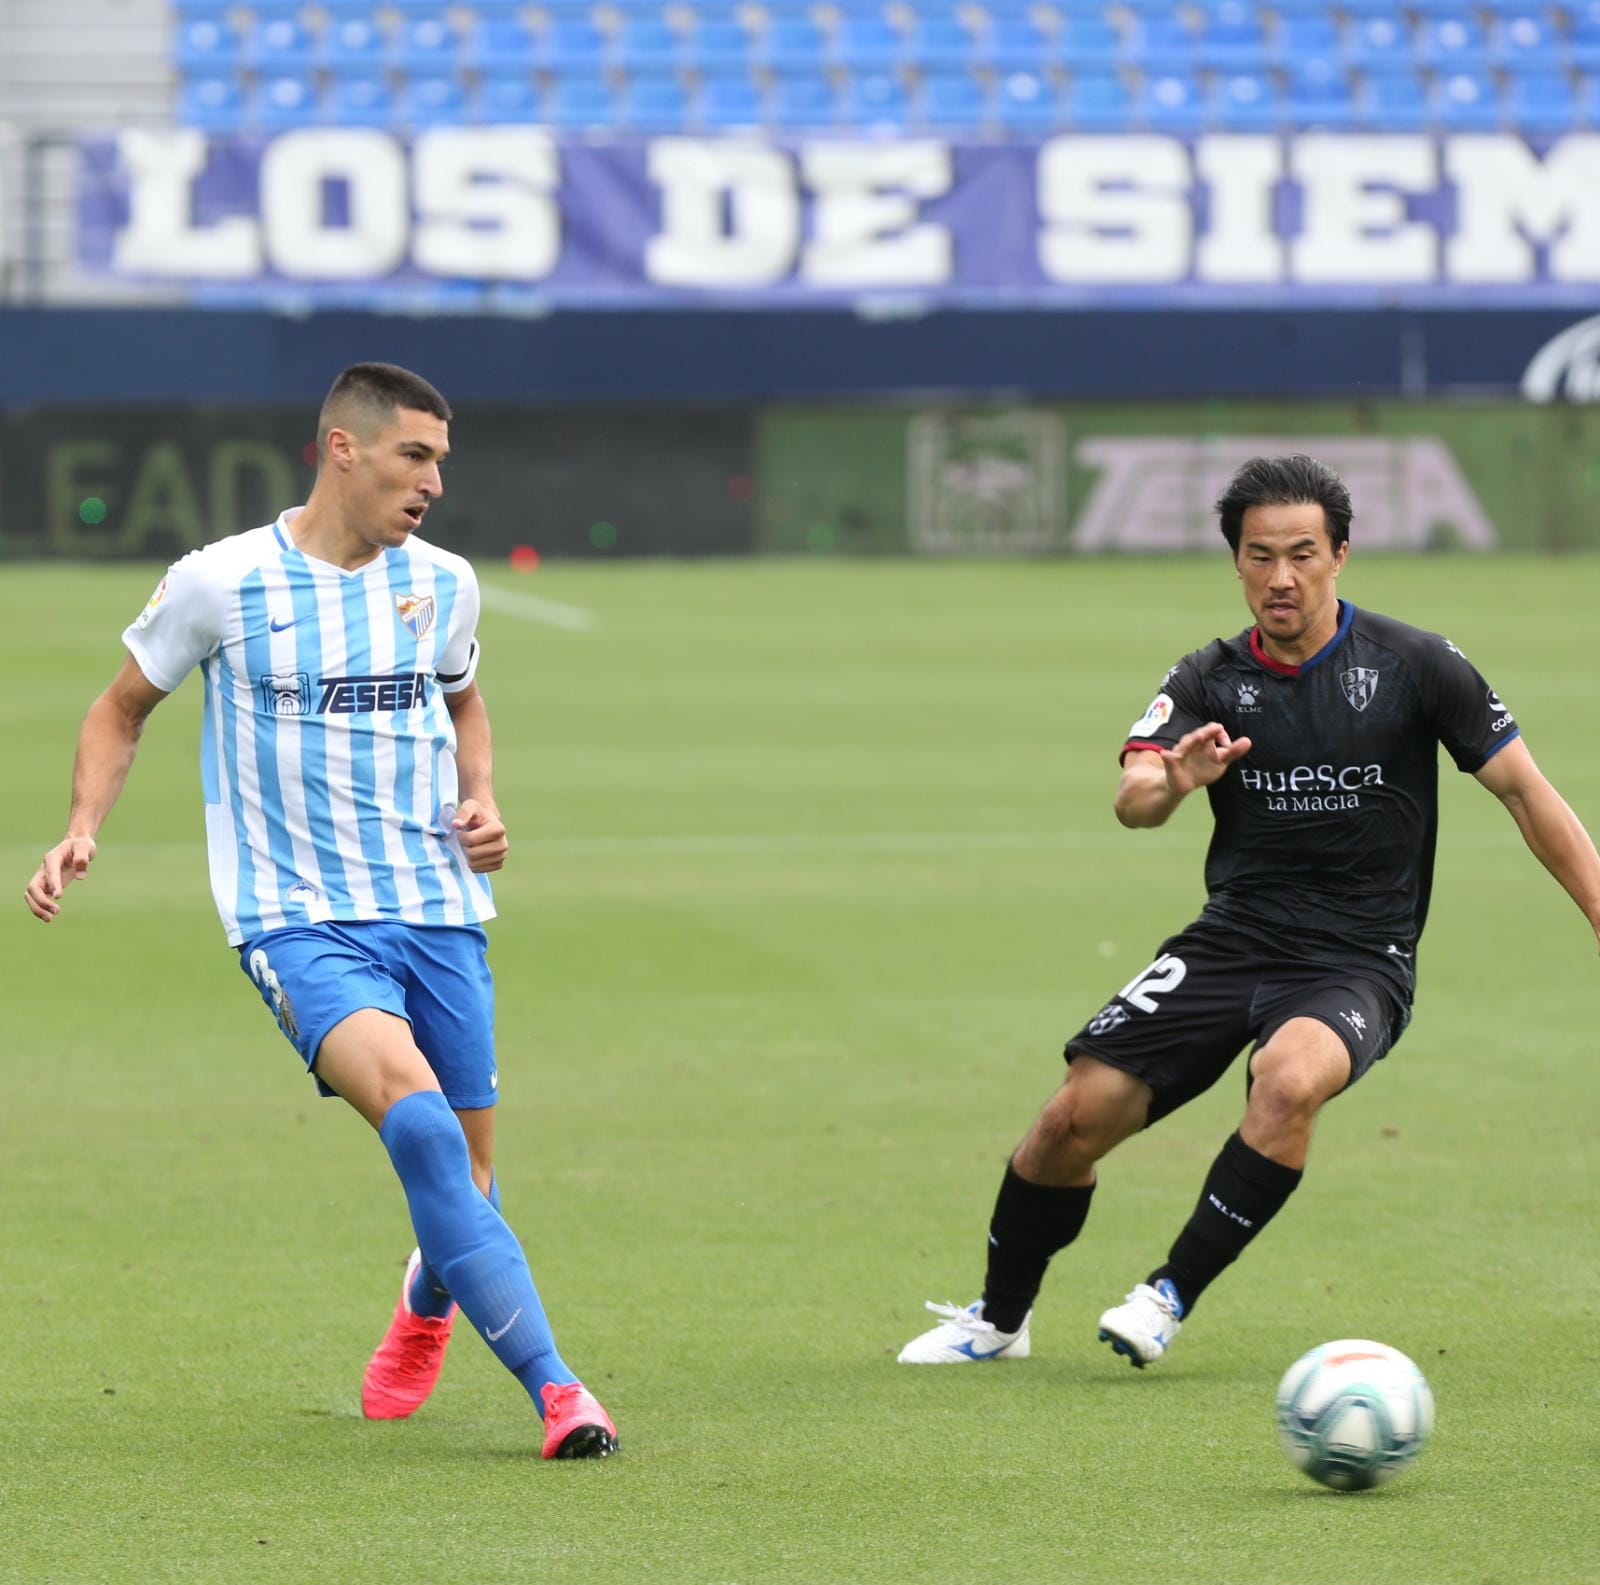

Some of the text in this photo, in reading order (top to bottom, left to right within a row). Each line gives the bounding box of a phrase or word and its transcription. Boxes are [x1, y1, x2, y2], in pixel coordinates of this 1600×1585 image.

[113, 127, 1600, 287] LOS DE SIEM
[1071, 434, 1496, 551] TESA
[316, 672, 428, 715] TESESA
[1118, 953, 1187, 1014] 12
